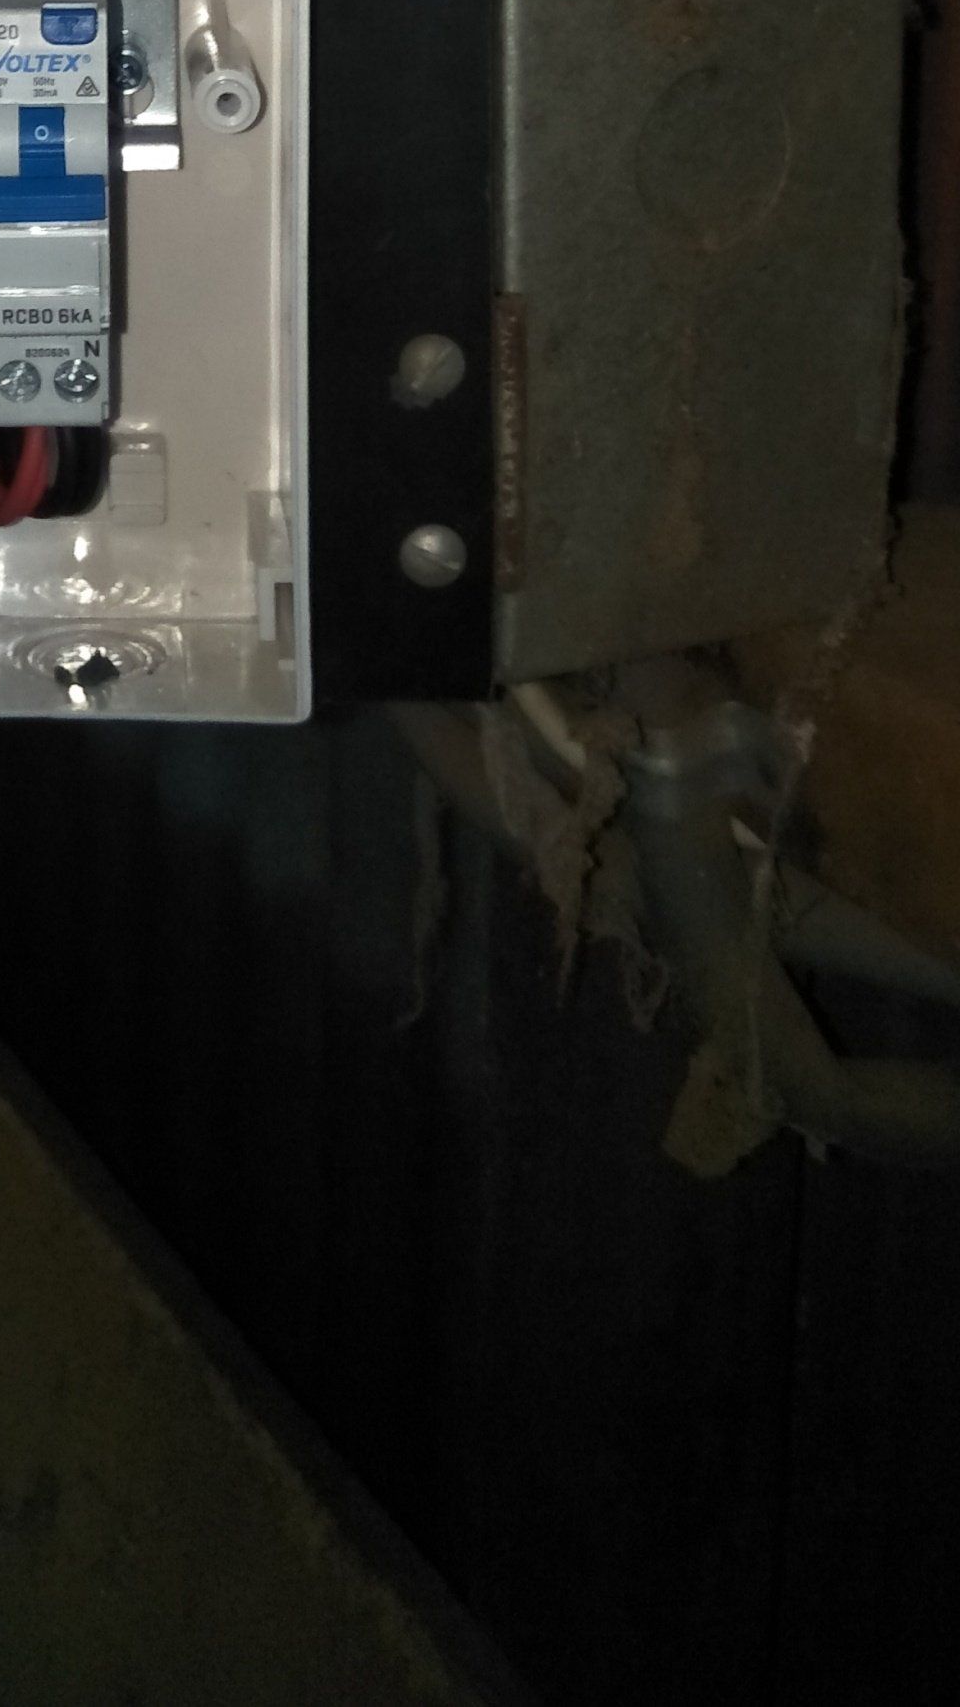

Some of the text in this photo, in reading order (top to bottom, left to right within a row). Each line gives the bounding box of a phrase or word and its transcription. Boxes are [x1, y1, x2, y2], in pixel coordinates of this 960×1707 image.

[2, 307, 93, 325] RCBO 6kA
[84, 340, 100, 358] N
